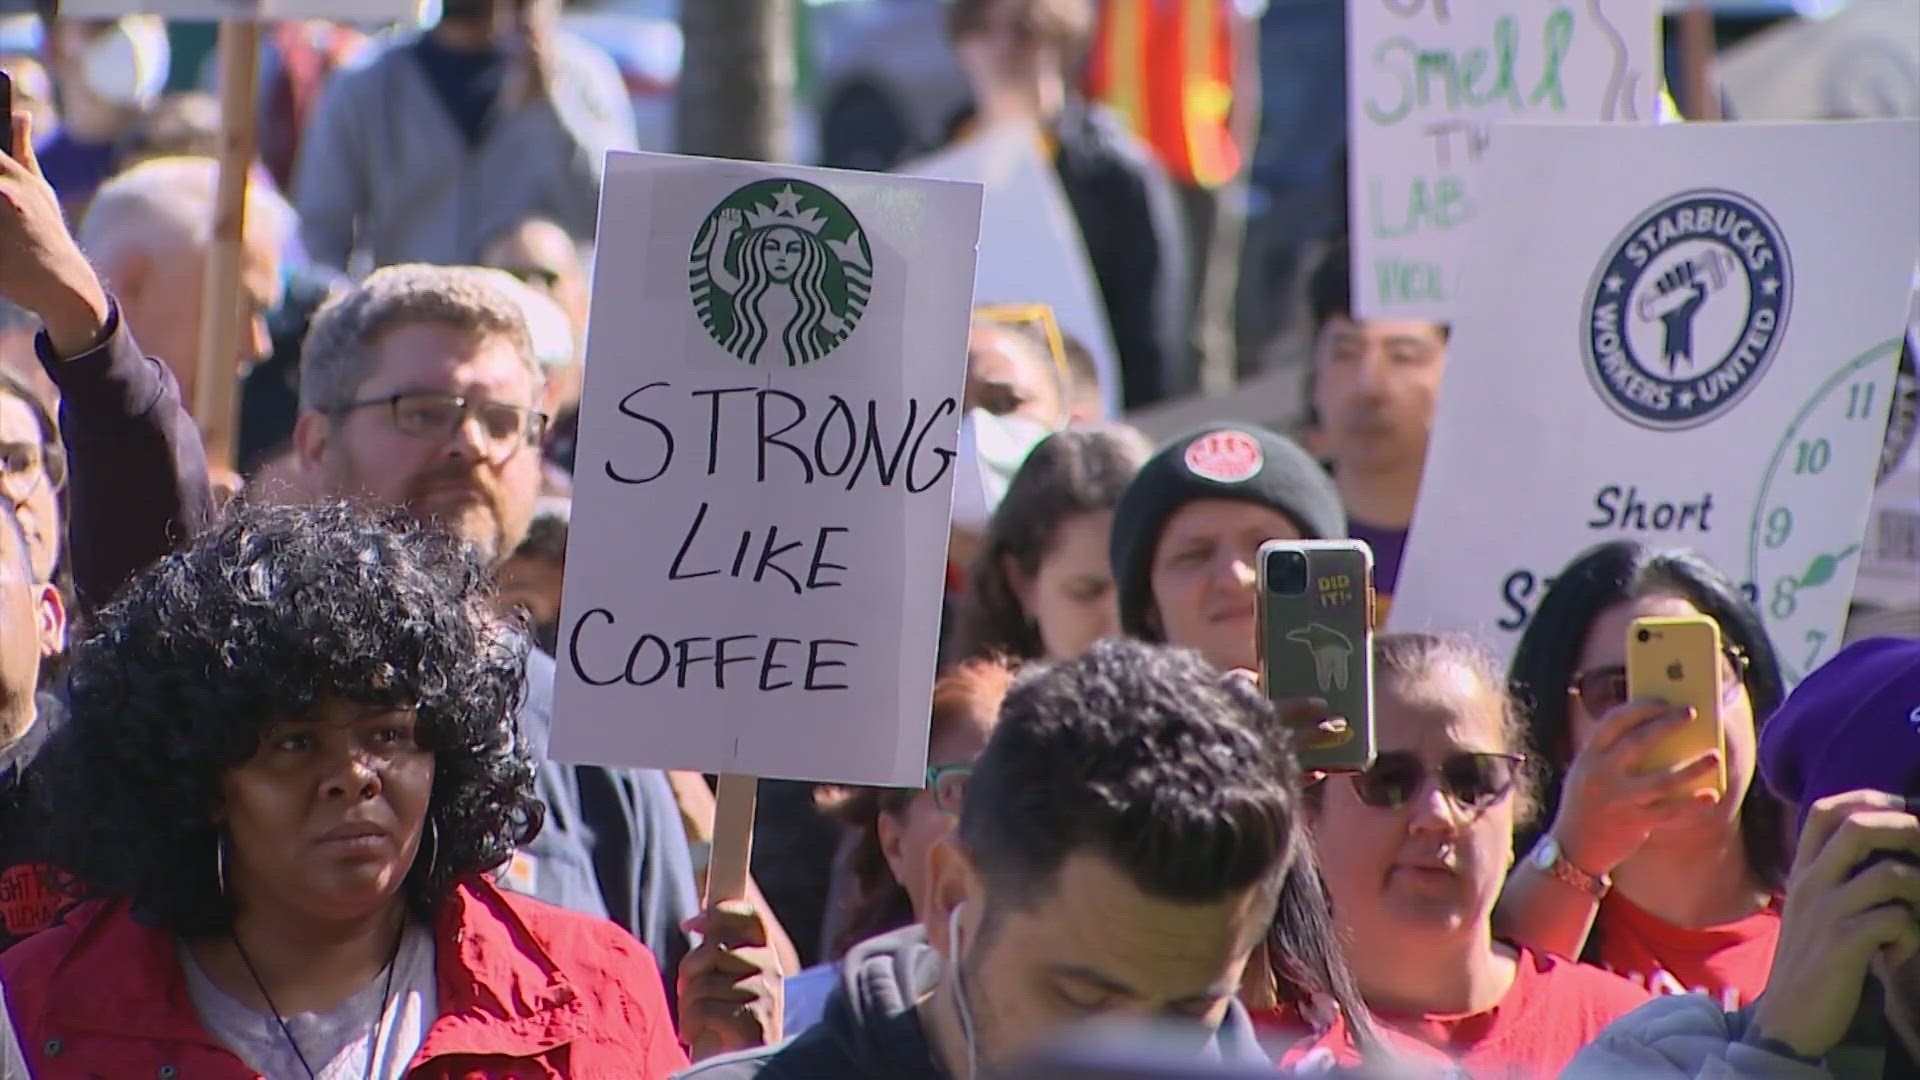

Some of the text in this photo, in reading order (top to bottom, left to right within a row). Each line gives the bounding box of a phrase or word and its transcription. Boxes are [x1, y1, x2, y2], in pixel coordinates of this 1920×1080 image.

[1363, 7, 1575, 126] Smell
[1624, 206, 1774, 272] STARBUCKS
[1594, 302, 1777, 411] WORKERS UNITED
[1844, 381, 1876, 419] 11
[605, 381, 958, 494] STRONG
[1793, 437, 1832, 475] 10
[1587, 483, 1715, 532] Short
[1764, 507, 1794, 549] 9
[668, 502, 850, 594] LIKE
[1317, 573, 1350, 591] DID
[1770, 574, 1799, 620] 8
[569, 608, 859, 691] COFFEE
[1804, 629, 1828, 672] 7
